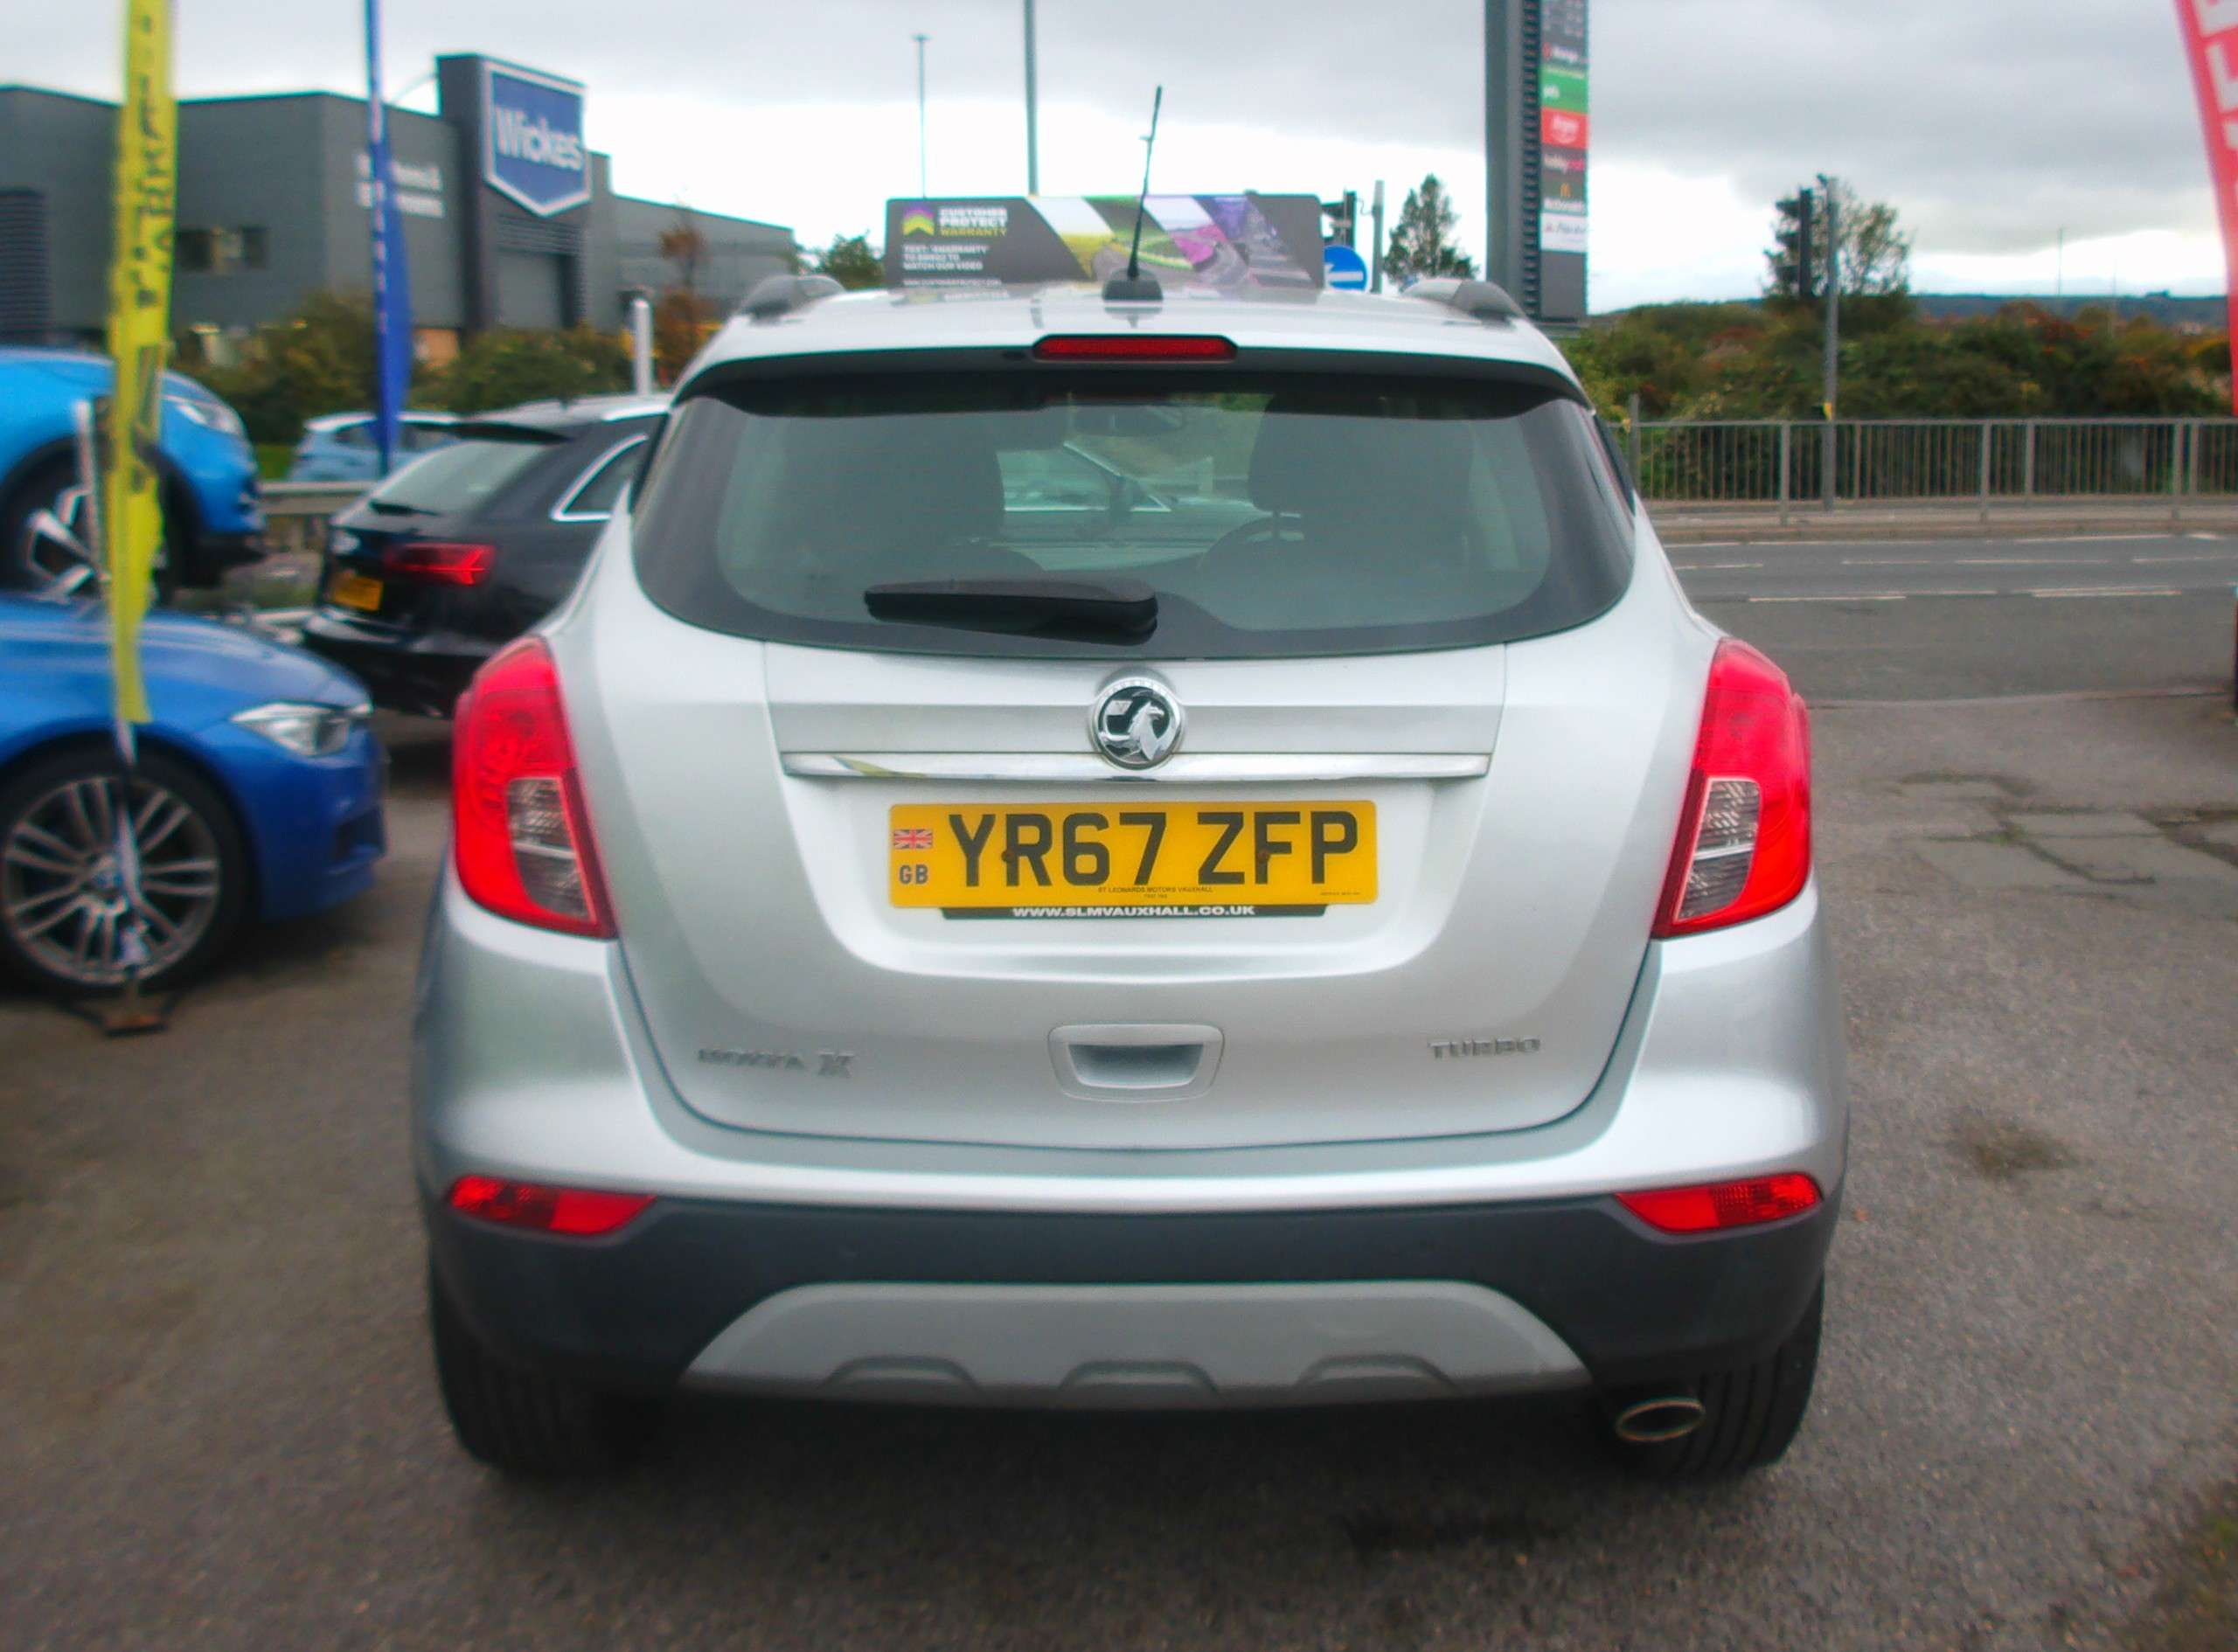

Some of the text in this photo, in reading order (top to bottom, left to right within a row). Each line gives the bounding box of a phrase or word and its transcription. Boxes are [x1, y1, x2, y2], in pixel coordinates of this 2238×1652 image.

[495, 105, 583, 170] Wickes
[939, 217, 1007, 227] PROTECT
[940, 227, 1007, 237] WARRANTY
[949, 811, 1358, 886] YR67 ZFP
[900, 864, 928, 885] GB
[1012, 905, 1255, 918] WWW.SLMVAUXHALL.CO.UK
[1428, 1038, 1541, 1059] TURBO
